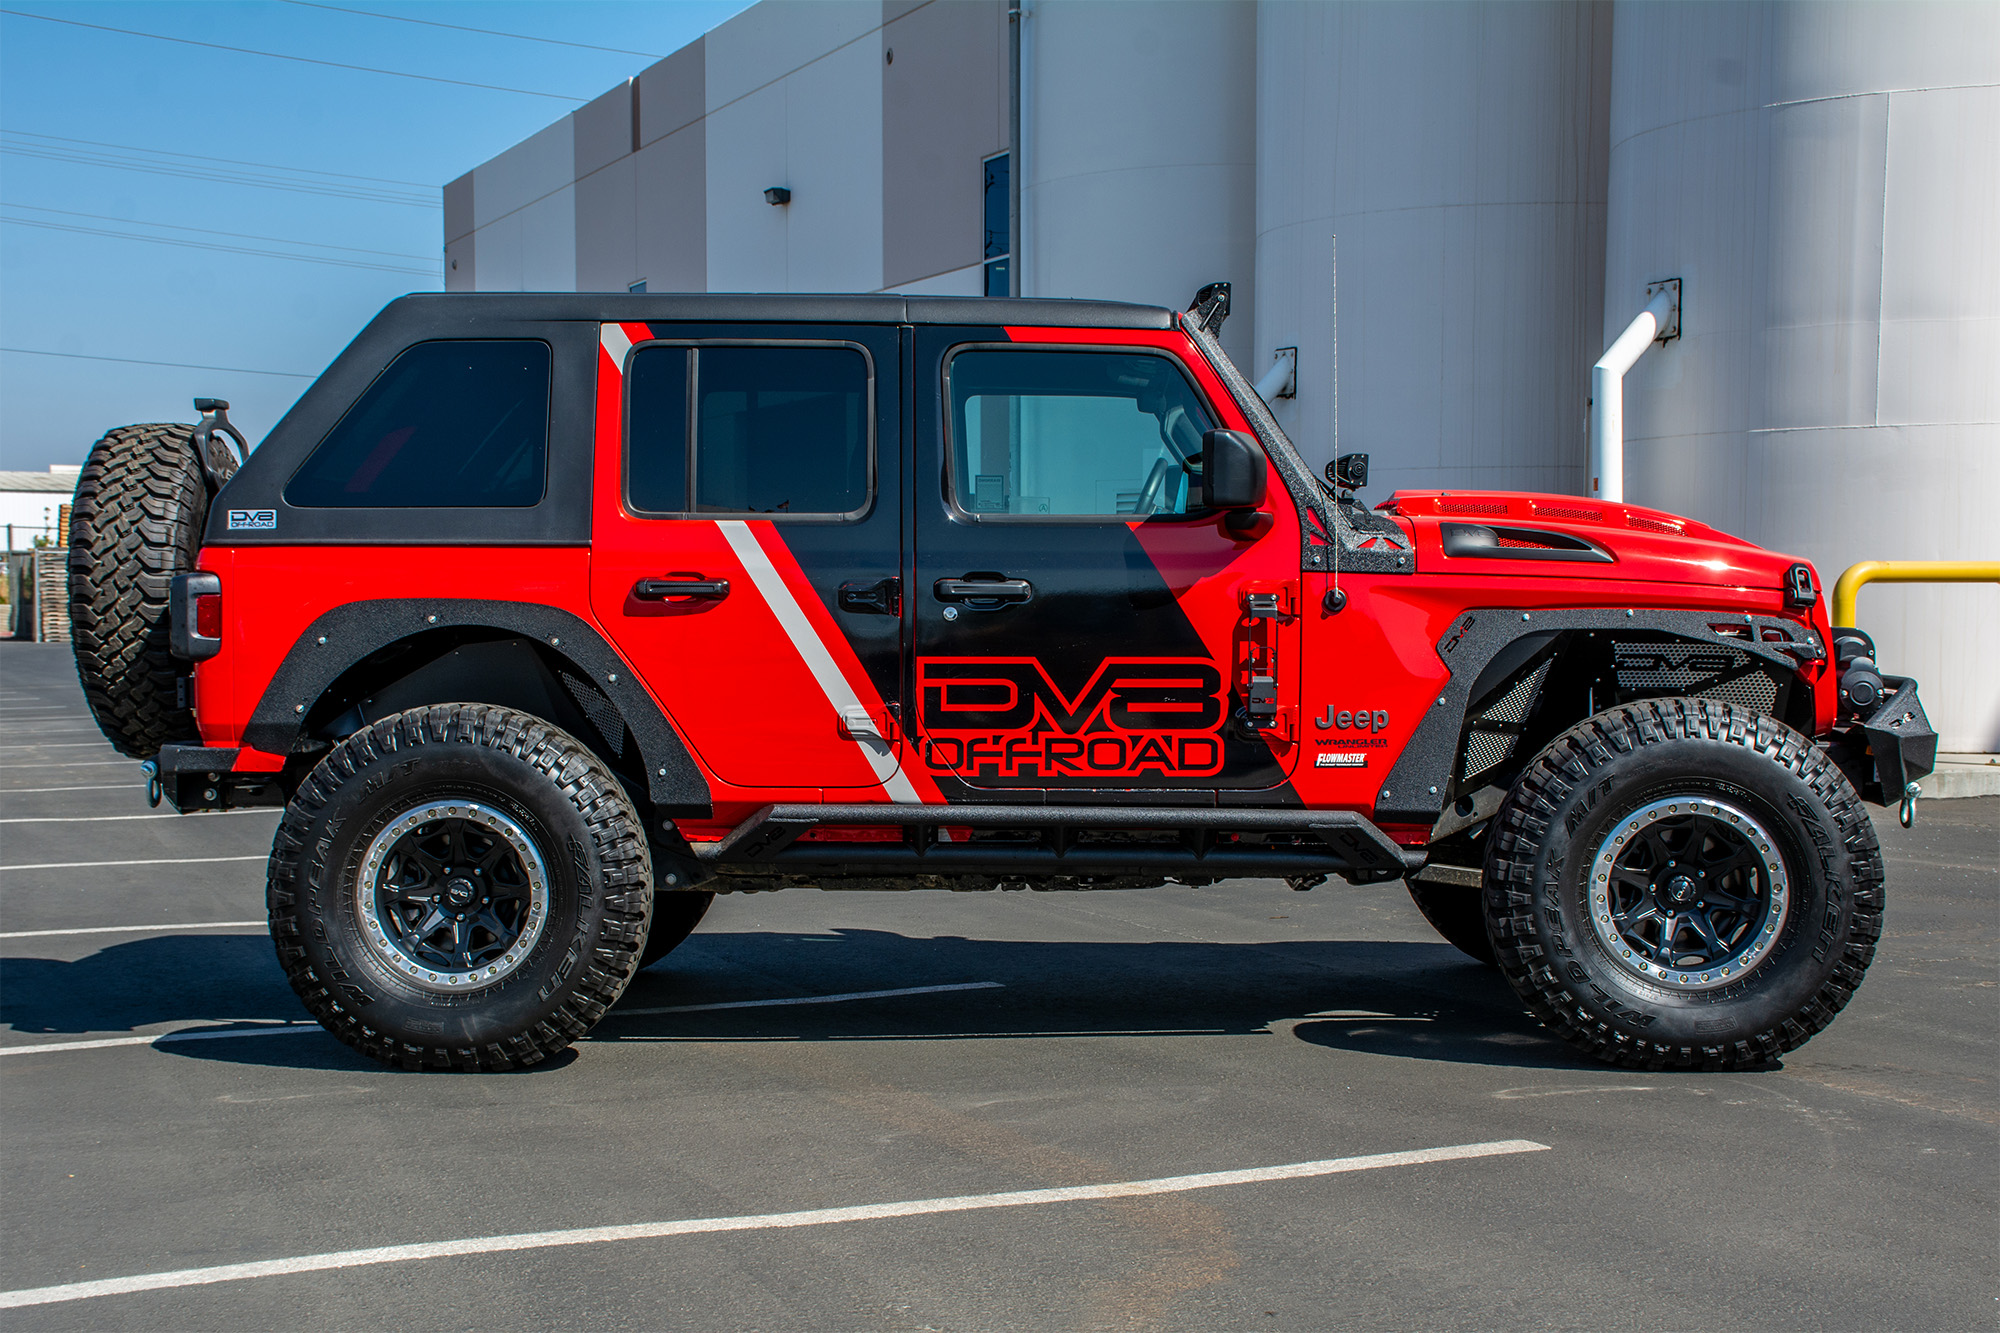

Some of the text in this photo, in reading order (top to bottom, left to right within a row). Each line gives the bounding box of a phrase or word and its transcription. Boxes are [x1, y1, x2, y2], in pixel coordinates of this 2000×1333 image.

[231, 511, 274, 522] DV8
[918, 657, 1228, 735] DV8
[1315, 704, 1390, 734] Jeep
[921, 735, 1222, 774] OFFROAD
[1316, 753, 1366, 766] FLOWMASTER
